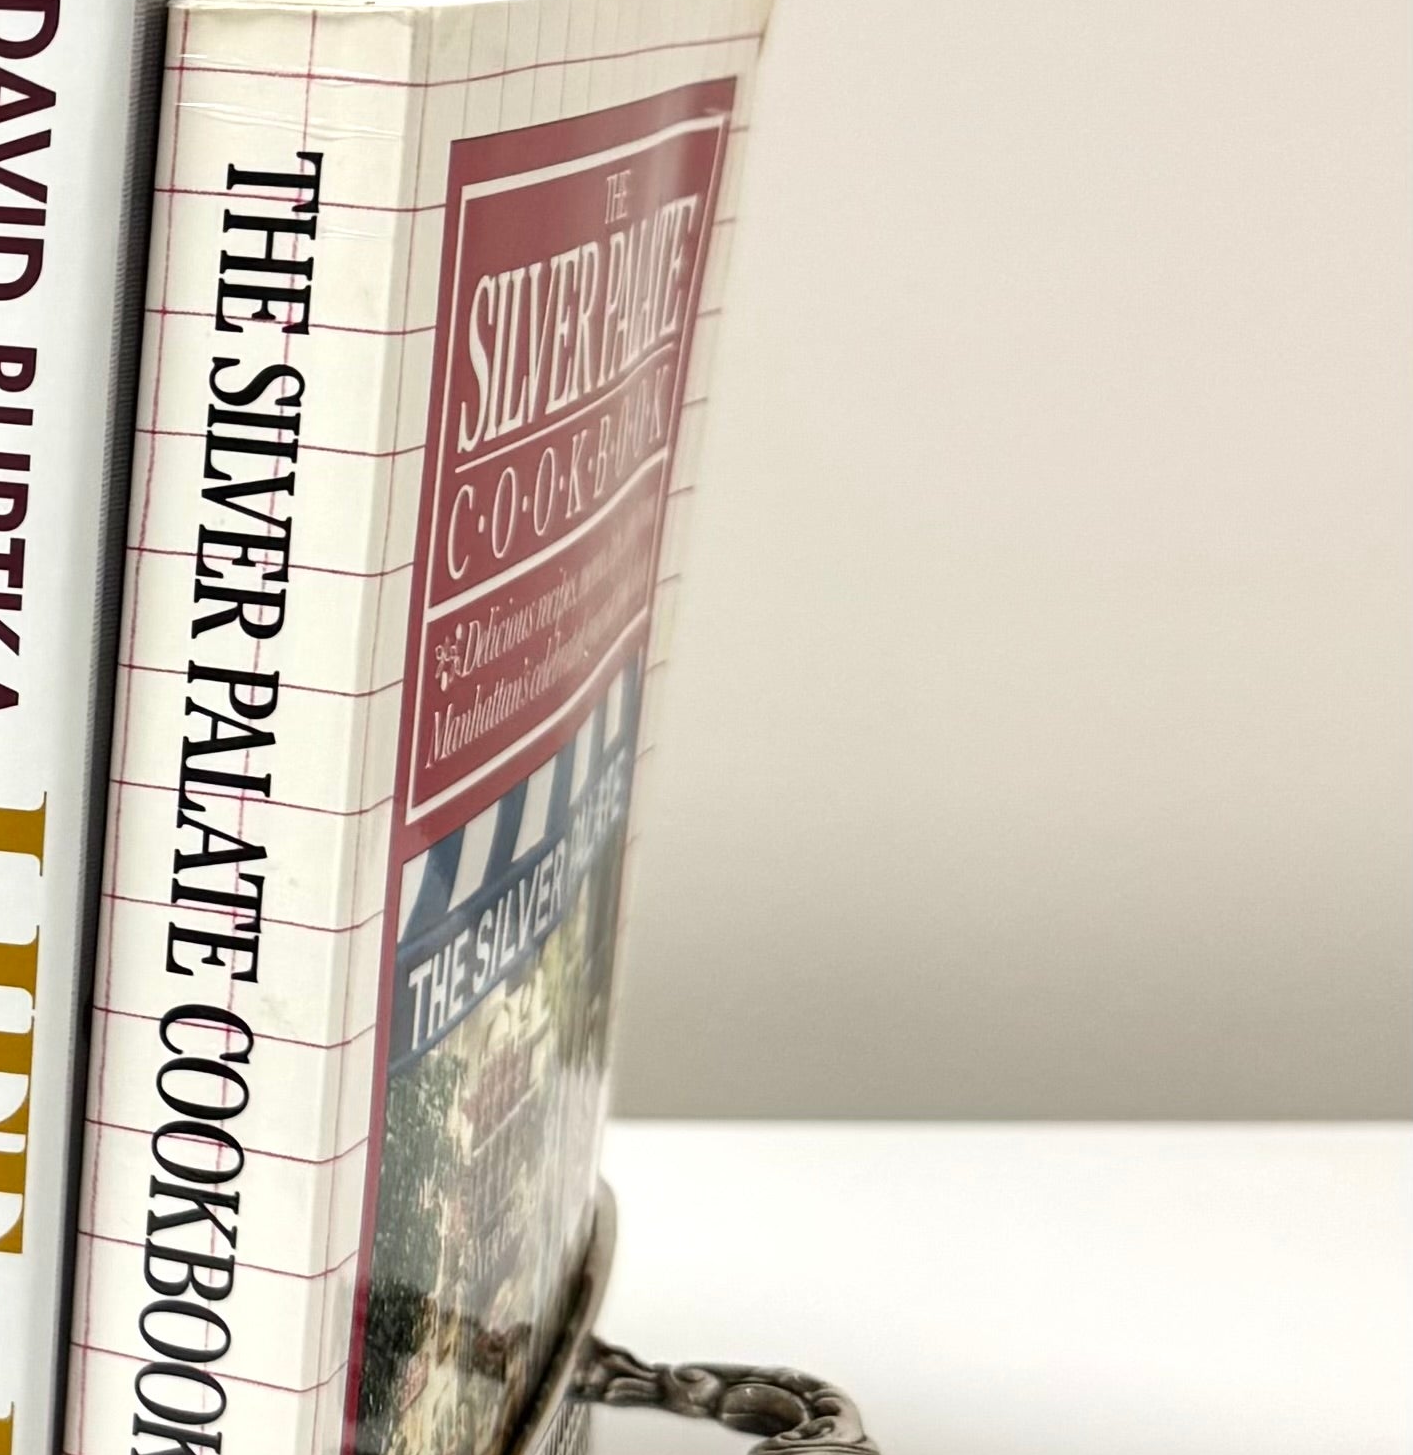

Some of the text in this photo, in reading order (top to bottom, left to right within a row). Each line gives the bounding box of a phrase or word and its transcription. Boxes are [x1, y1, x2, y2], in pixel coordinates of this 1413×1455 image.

[214, 150, 325, 337] THE
[603, 168, 633, 226] THE
[456, 192, 700, 455] SILVER PALATE
[190, 356, 307, 641] SILVER
[460, 596, 535, 679] Delicious
[165, 658, 281, 984] PALATE
[407, 927, 473, 1053] THE
[471, 835, 568, 994] SILVER
